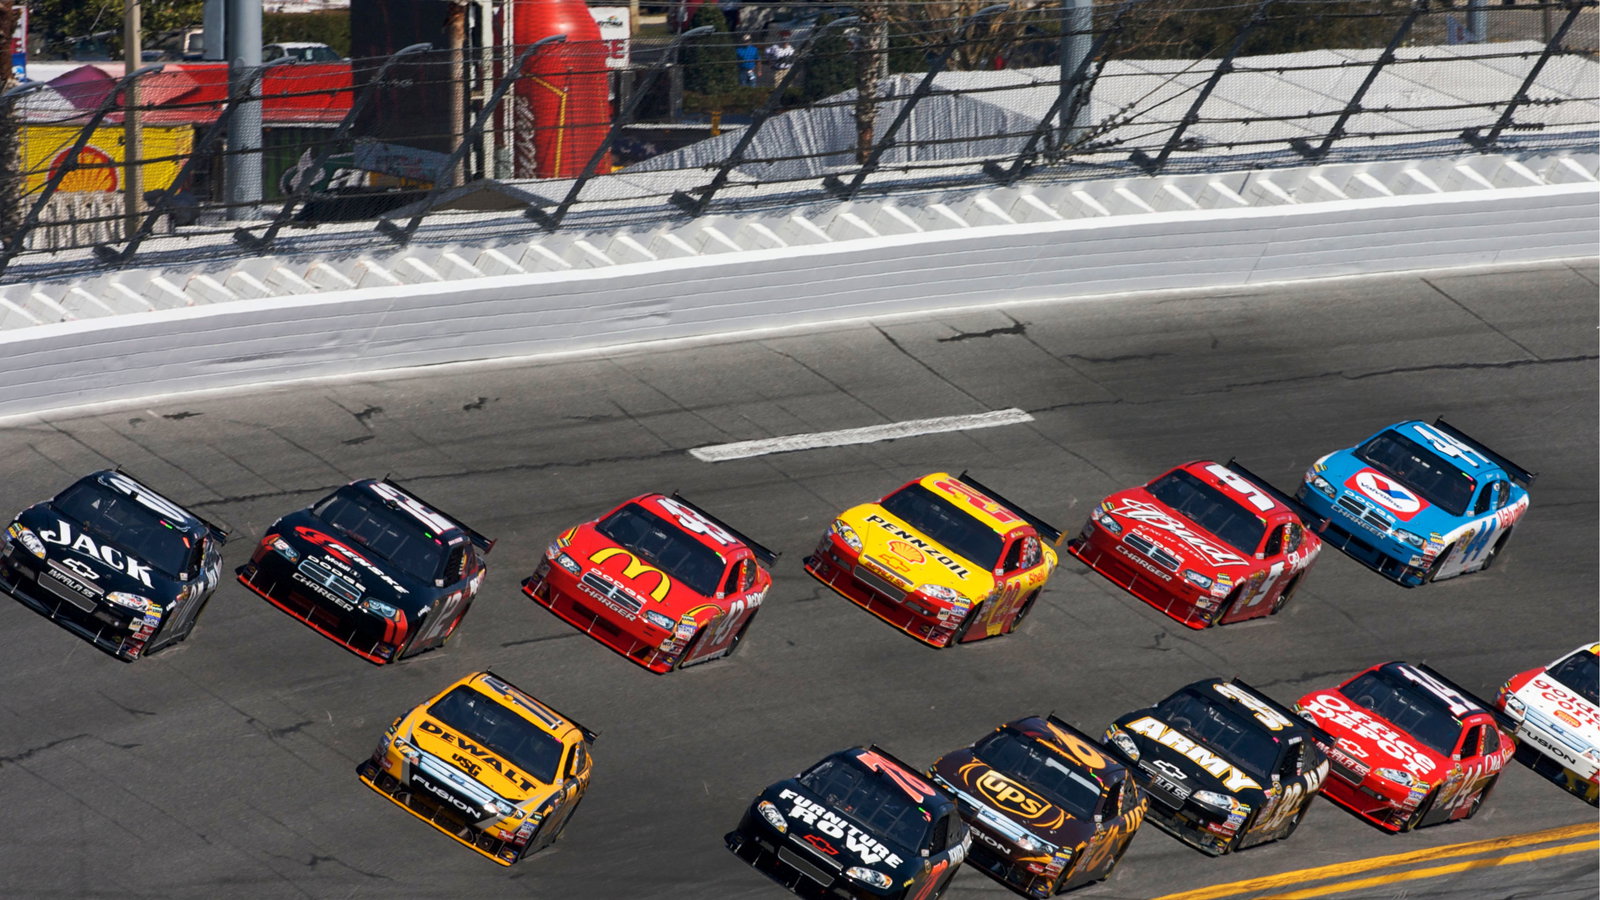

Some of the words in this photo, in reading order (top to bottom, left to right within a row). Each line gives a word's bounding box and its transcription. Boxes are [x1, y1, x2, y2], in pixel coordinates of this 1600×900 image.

[1413, 422, 1491, 468] 44
[369, 481, 457, 536] 12
[1205, 463, 1275, 512] 9
[1344, 489, 1396, 523] DODGE
[1361, 482, 1403, 510] Valvoline
[656, 497, 738, 547] 43
[1122, 498, 1243, 564] Bud
[1331, 504, 1387, 540] CHARGER
[40, 519, 155, 590] JACK
[324, 554, 351, 572] Mobil
[328, 543, 410, 594] PENSKE
[865, 515, 970, 580] PENNZOIL
[1115, 544, 1173, 582] CHARGER
[1132, 528, 1185, 563] DODGE
[48, 569, 83, 592] IMPALA
[82, 588, 96, 598] SS
[292, 572, 354, 612] CHARGER
[308, 554, 366, 593] DODGE
[590, 567, 648, 605] DODGE
[576, 583, 638, 622] CHARGER
[1397, 664, 1478, 717] 14
[1541, 692, 1599, 731] corr
[1125, 716, 1262, 792] ARMY
[1316, 694, 1436, 772] Office
[418, 720, 537, 793] DEWALT
[451, 753, 482, 777] USG
[412, 774, 482, 820] FUSION
[779, 788, 904, 869] FURNITURE
[788, 805, 881, 864] ROW
[970, 825, 1011, 855] SION
